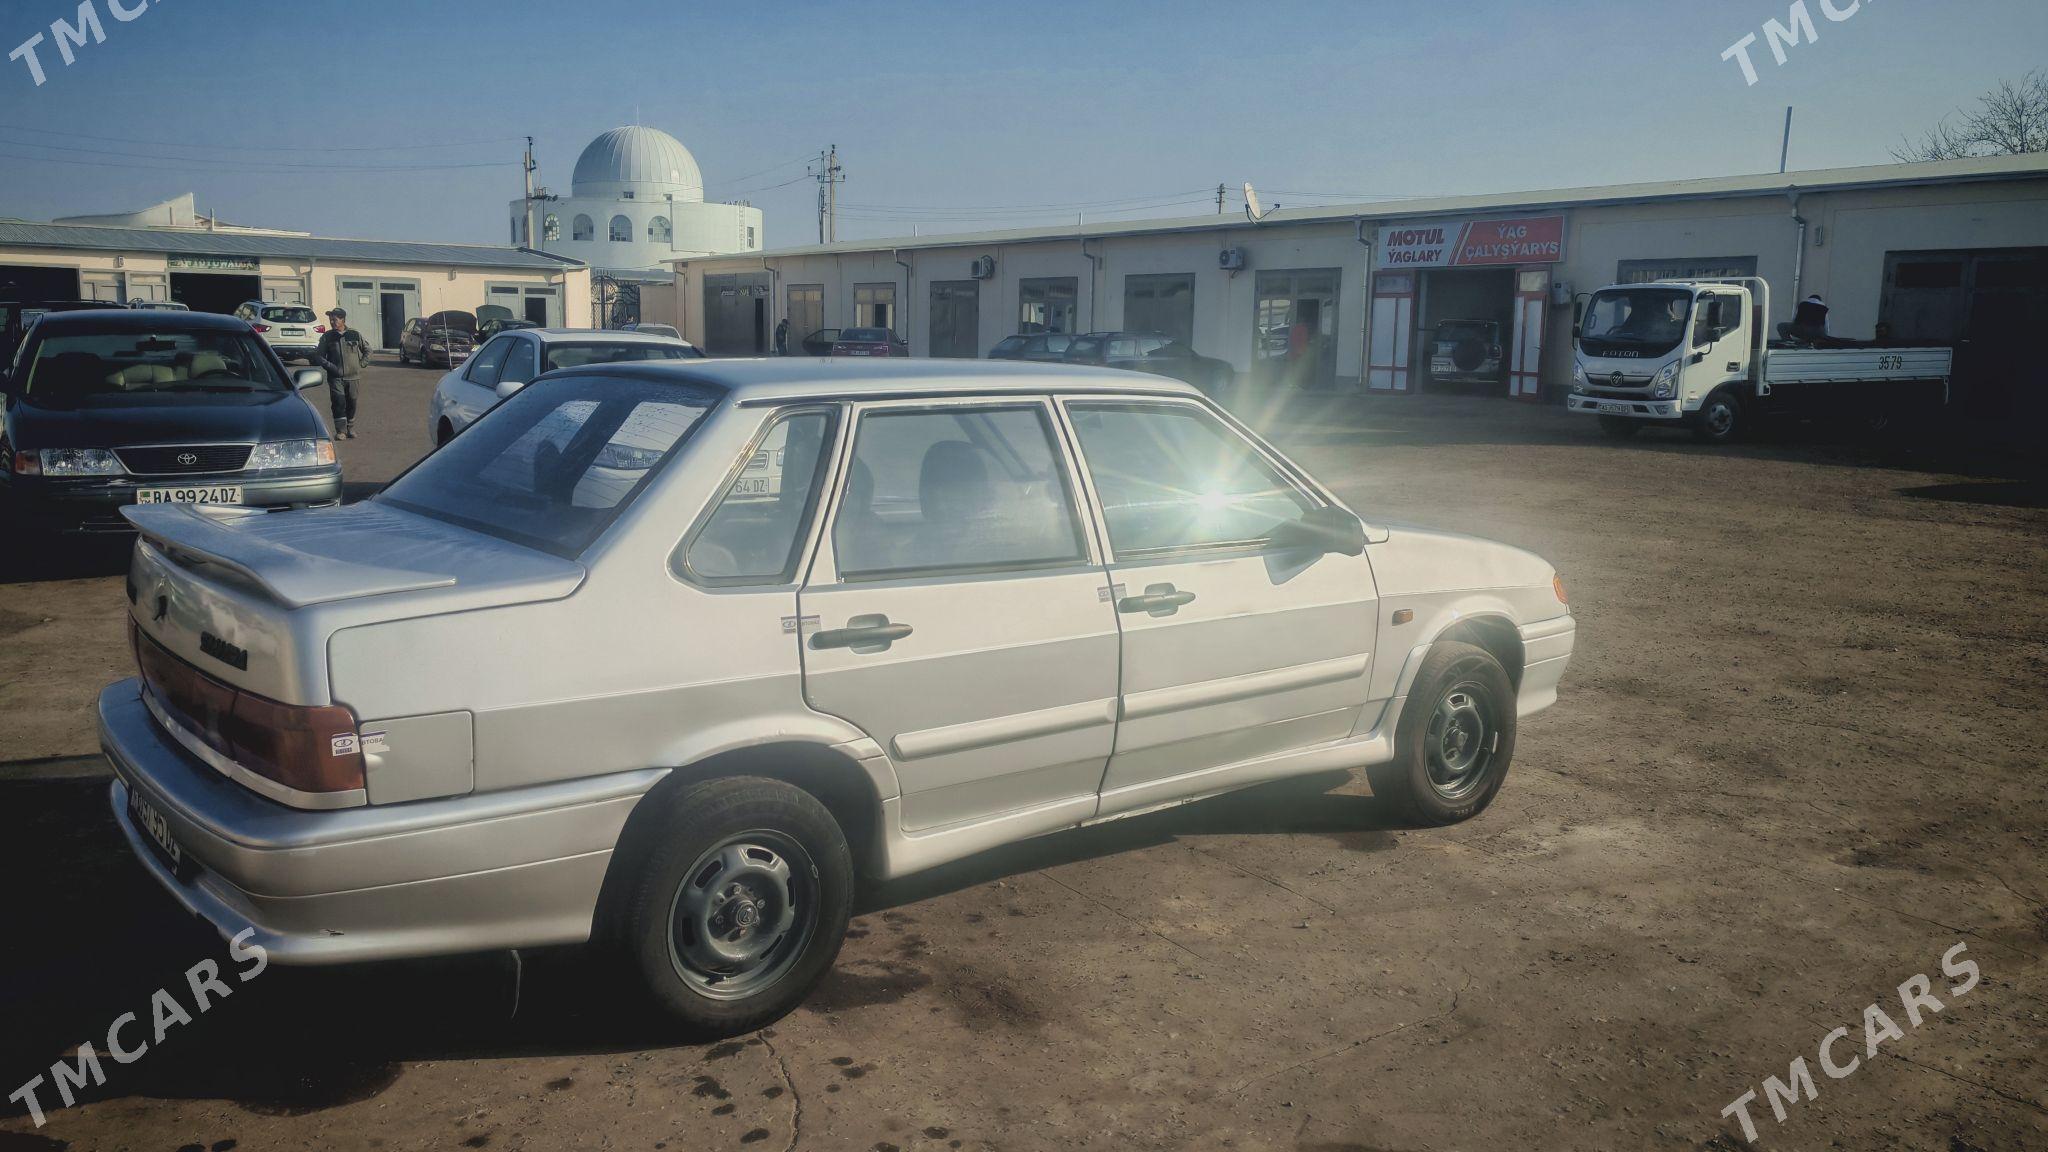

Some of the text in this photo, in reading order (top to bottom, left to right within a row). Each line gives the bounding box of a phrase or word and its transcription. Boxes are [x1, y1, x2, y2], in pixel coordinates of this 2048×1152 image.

[1386, 228, 1445, 247] MOTUL
[1497, 223, 1528, 240] ÝAG
[1388, 248, 1443, 264] ÝAGLARY
[1878, 355, 1903, 370] 3579
[753, 479, 766, 493] DZ
